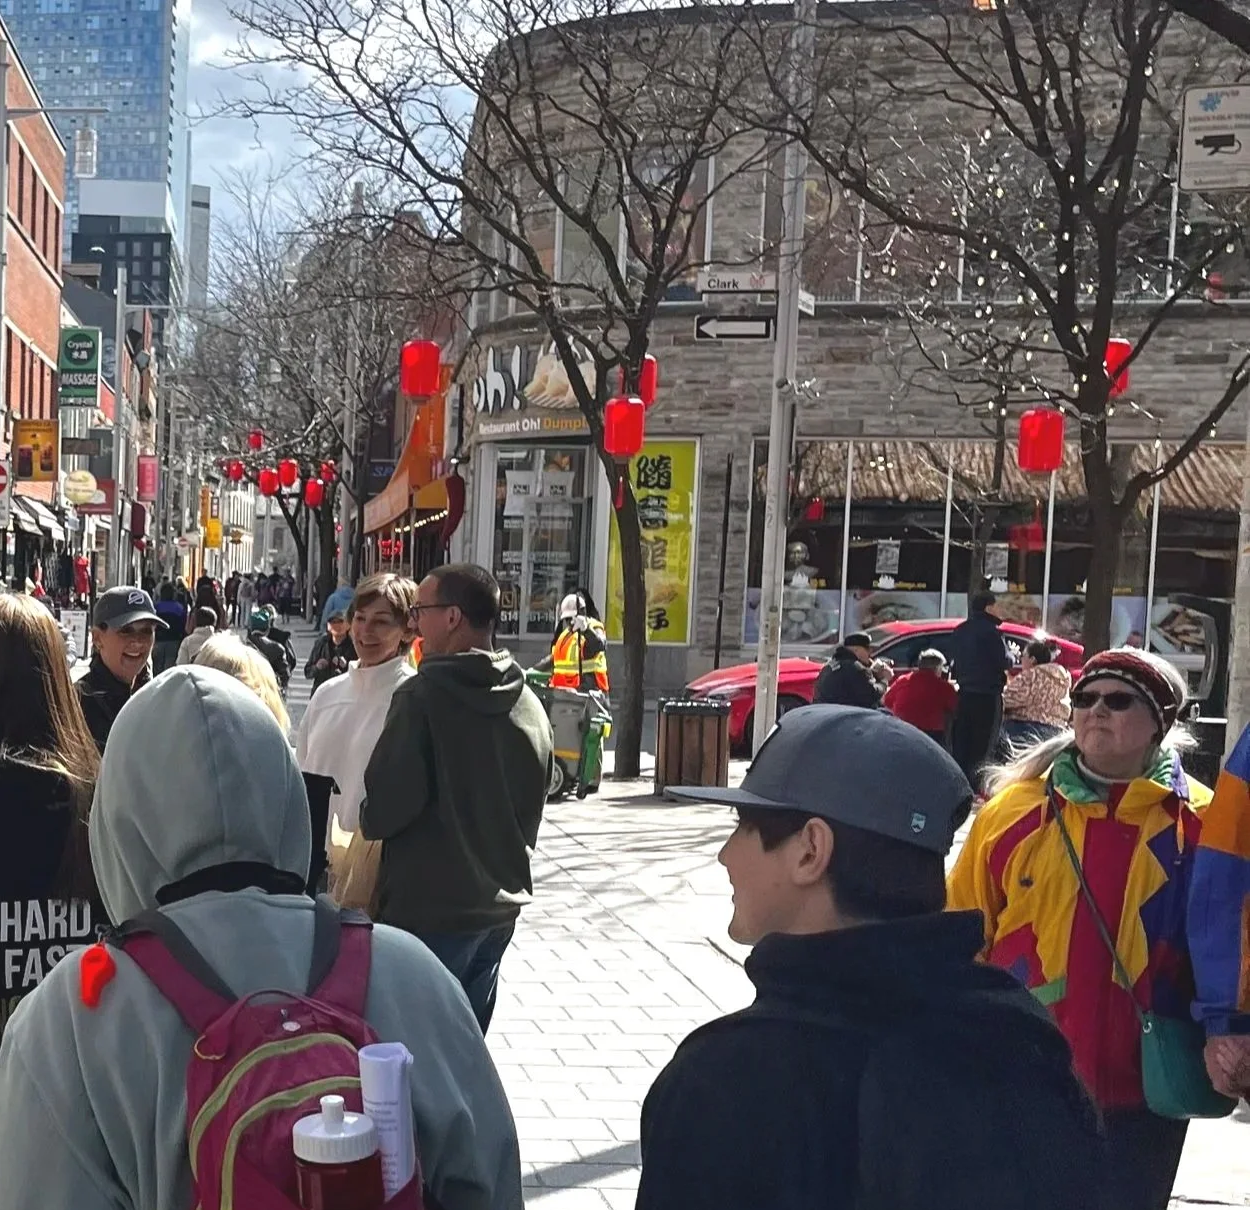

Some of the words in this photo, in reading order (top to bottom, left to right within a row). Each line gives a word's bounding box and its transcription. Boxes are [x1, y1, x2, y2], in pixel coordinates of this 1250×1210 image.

[707, 278, 739, 290] Clark
[66, 340, 93, 350] Crystal
[61, 373, 97, 386] MASSAGE
[478, 417, 521, 435] Restaurant
[521, 415, 541, 432] Oh!
[373, 466, 393, 478] SP
[500, 611, 518, 622] 514
[0, 898, 91, 943] HARD
[4, 943, 87, 990] FAS
